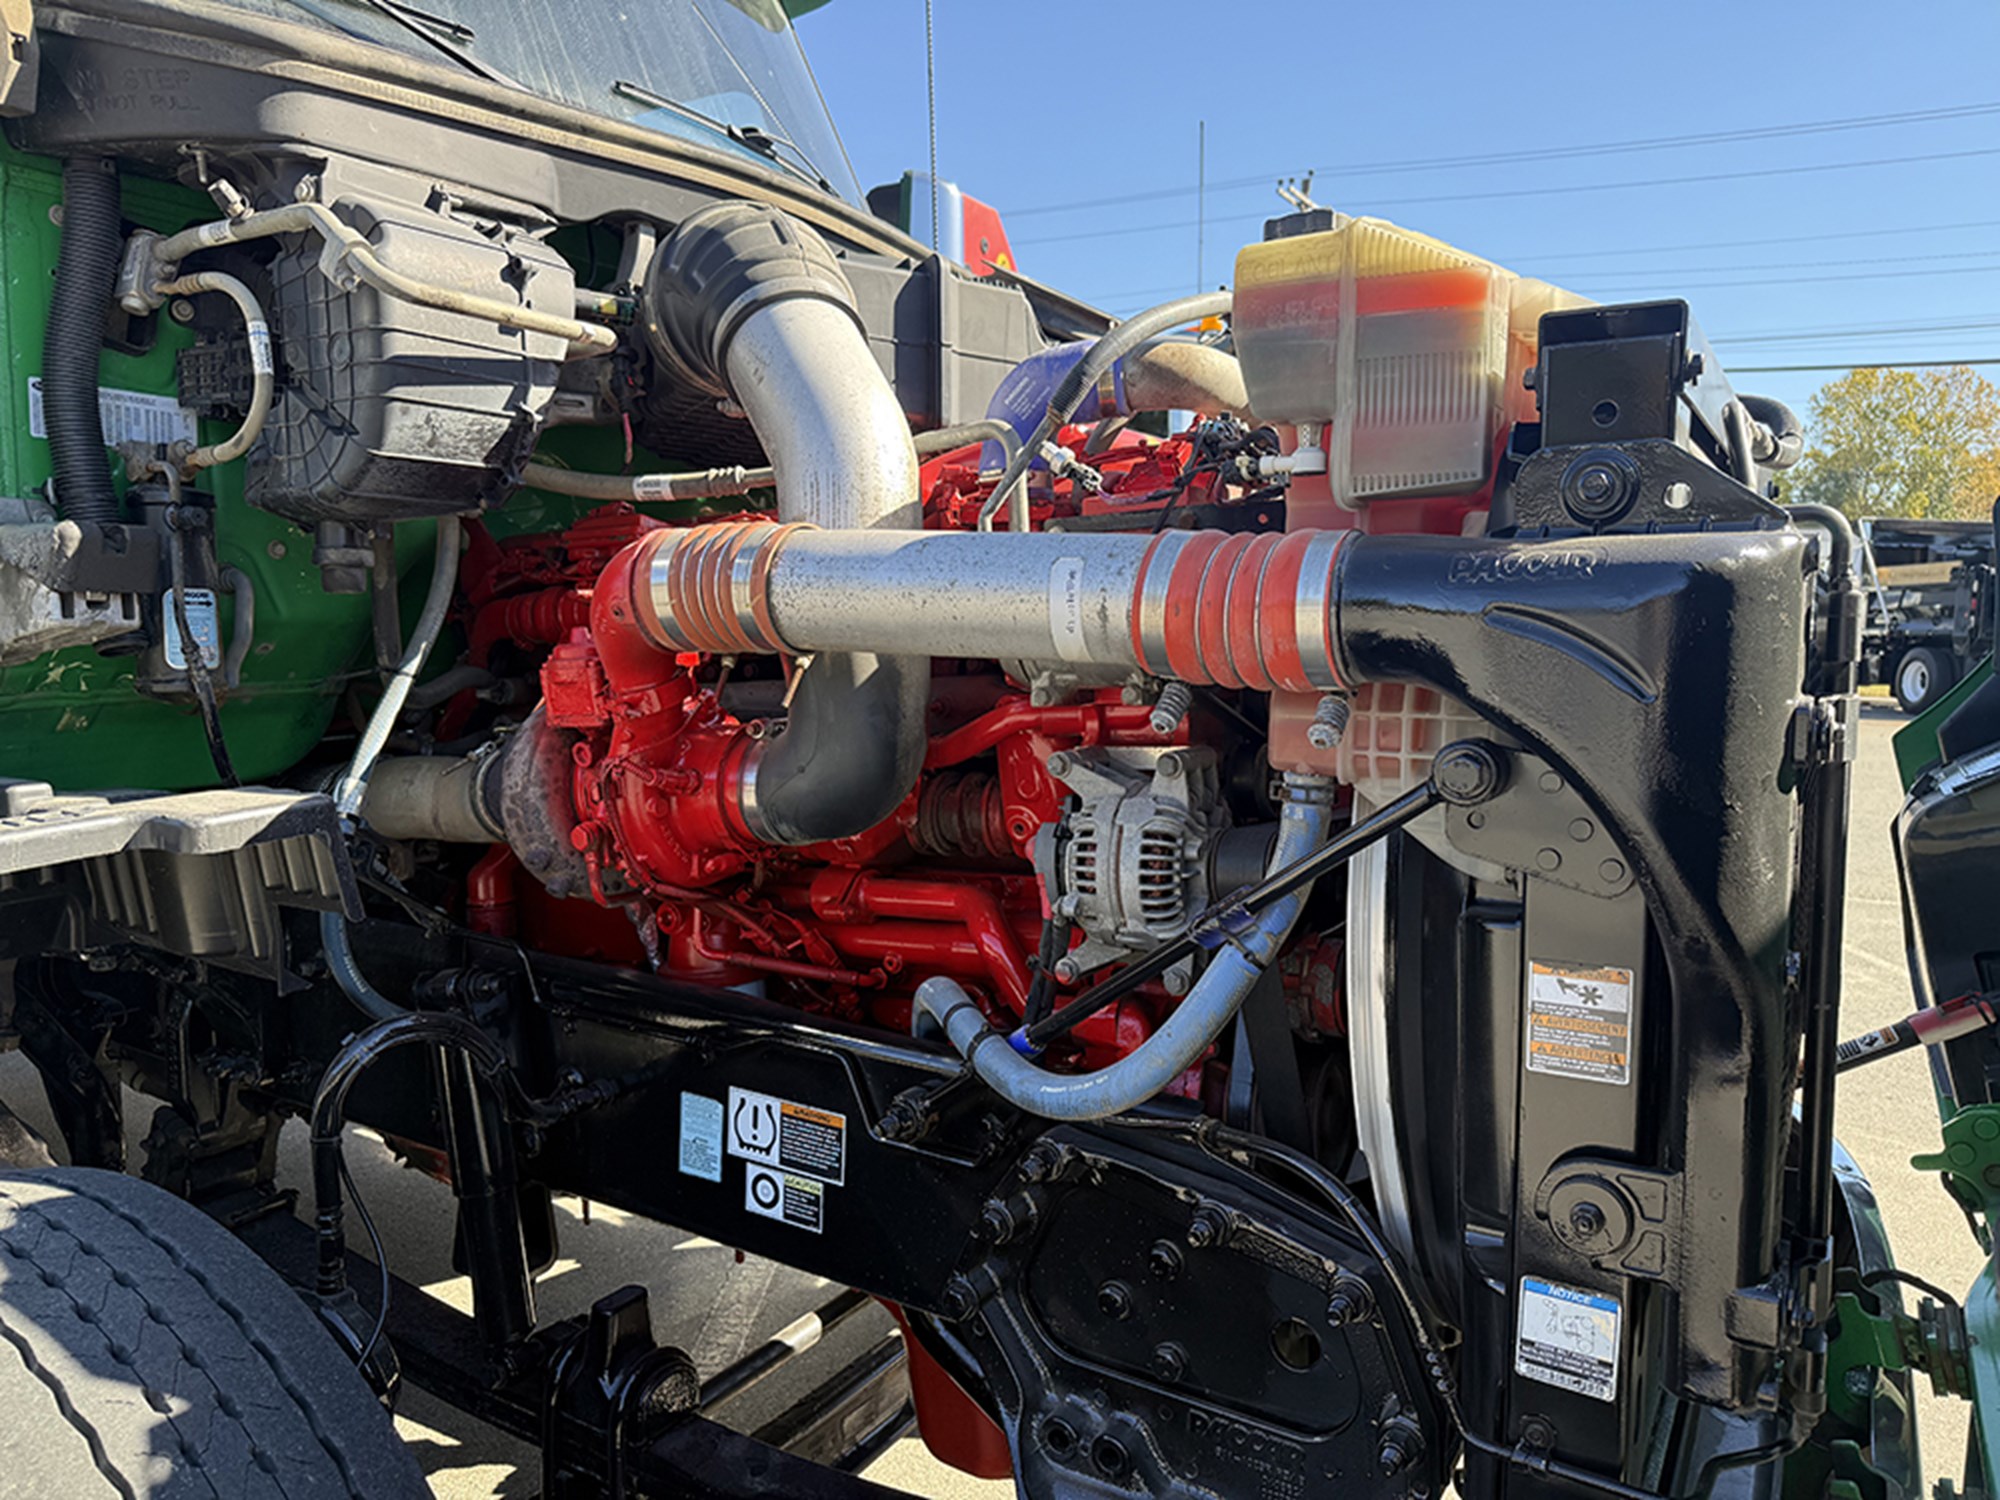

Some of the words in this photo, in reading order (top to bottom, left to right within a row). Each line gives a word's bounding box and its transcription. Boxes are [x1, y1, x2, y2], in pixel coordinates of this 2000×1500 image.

[121, 66, 191, 90] STEP
[103, 94, 137, 110] NOT
[149, 93, 202, 111] PULL
[1236, 251, 1336, 283] COOLANT
[1448, 551, 1598, 584] PACCAR
[1547, 1015, 1626, 1037] AVERTISSEMENT
[1547, 1285, 1593, 1304] NOTICE
